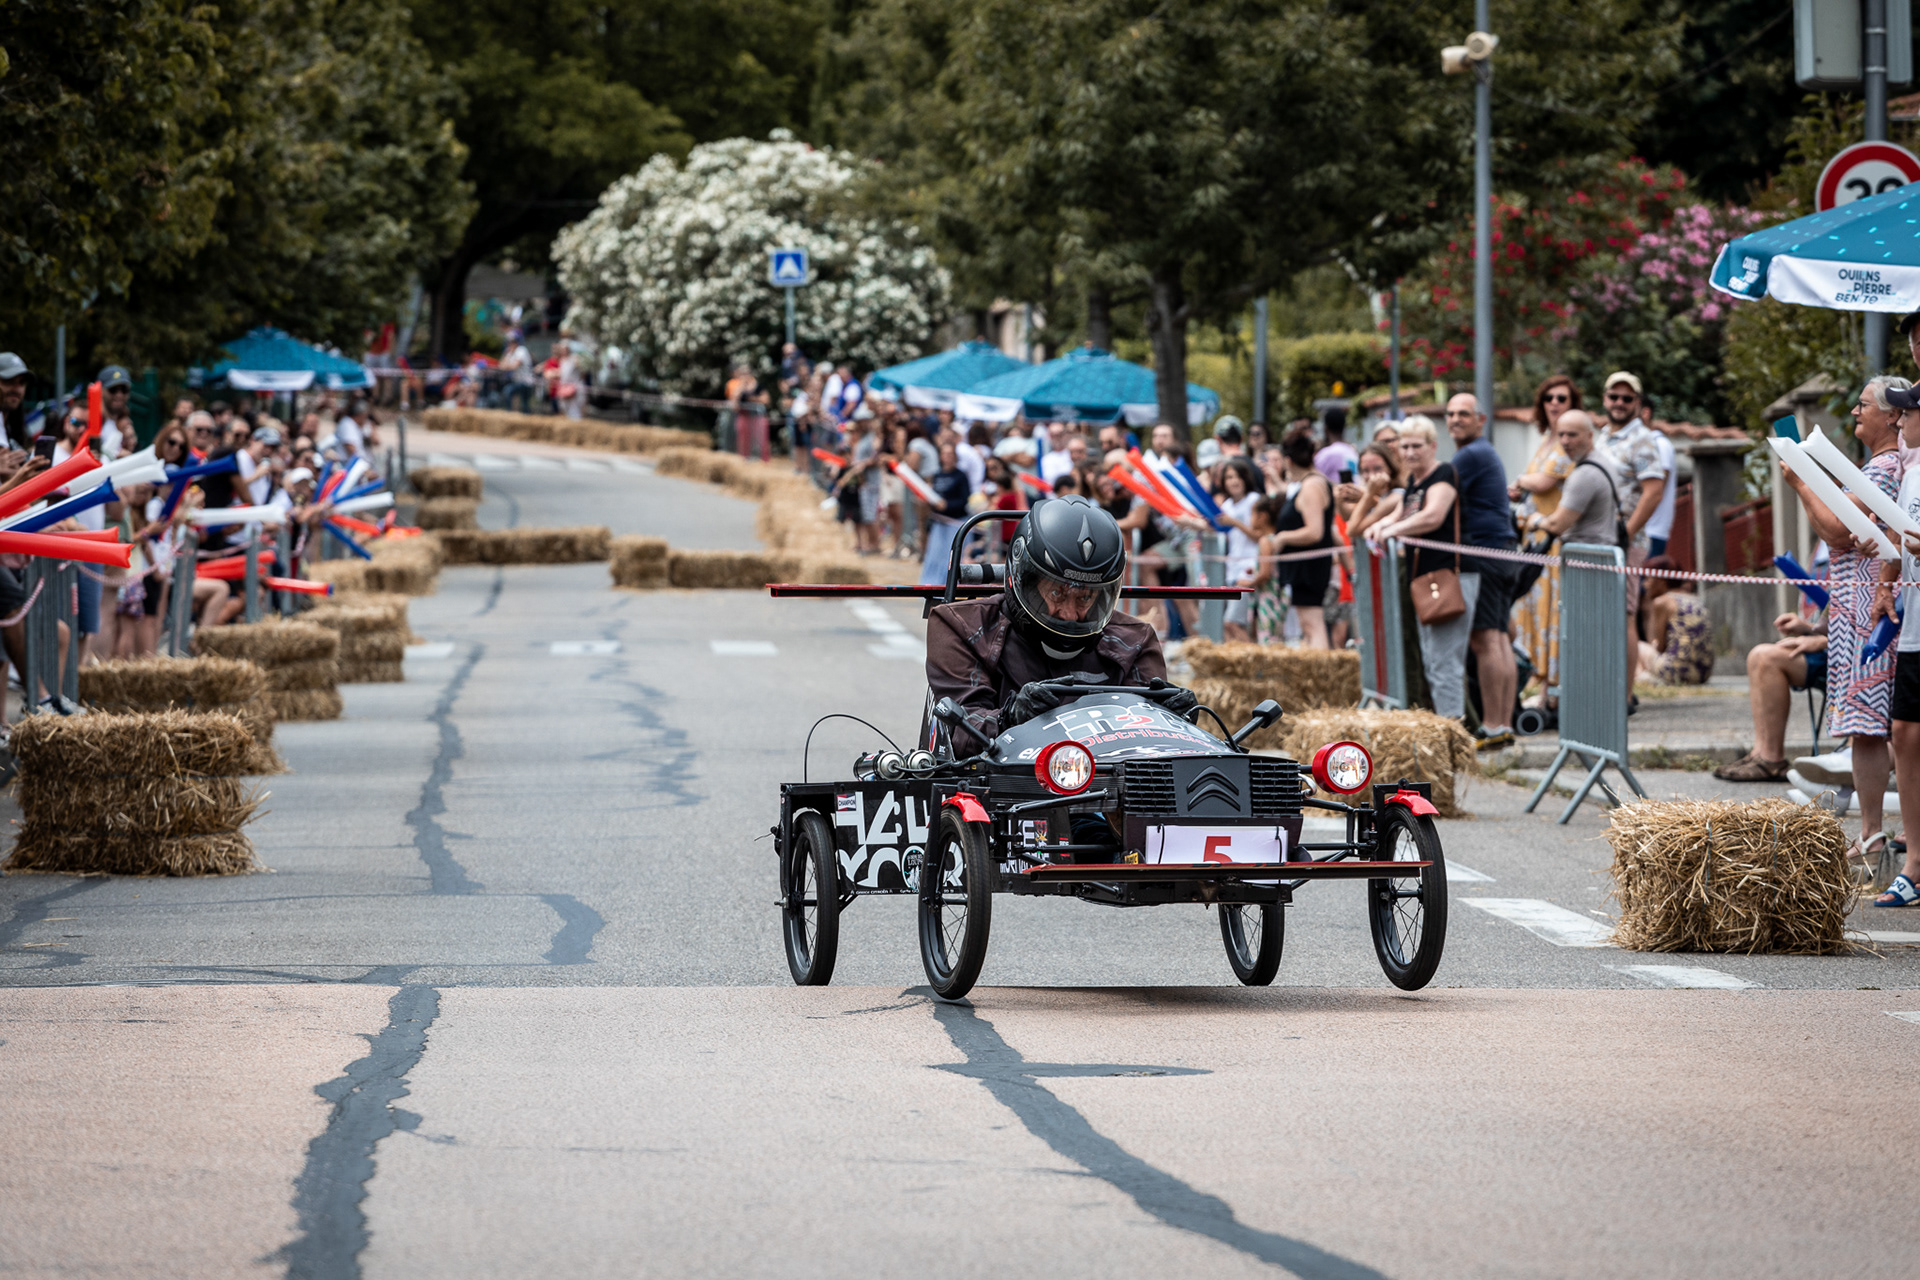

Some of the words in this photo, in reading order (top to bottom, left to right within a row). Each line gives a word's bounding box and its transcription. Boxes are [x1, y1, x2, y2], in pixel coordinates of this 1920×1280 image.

[1853, 279, 1891, 295] PIERRE
[1063, 568, 1102, 582] SHARK
[1203, 836, 1232, 862] 5
